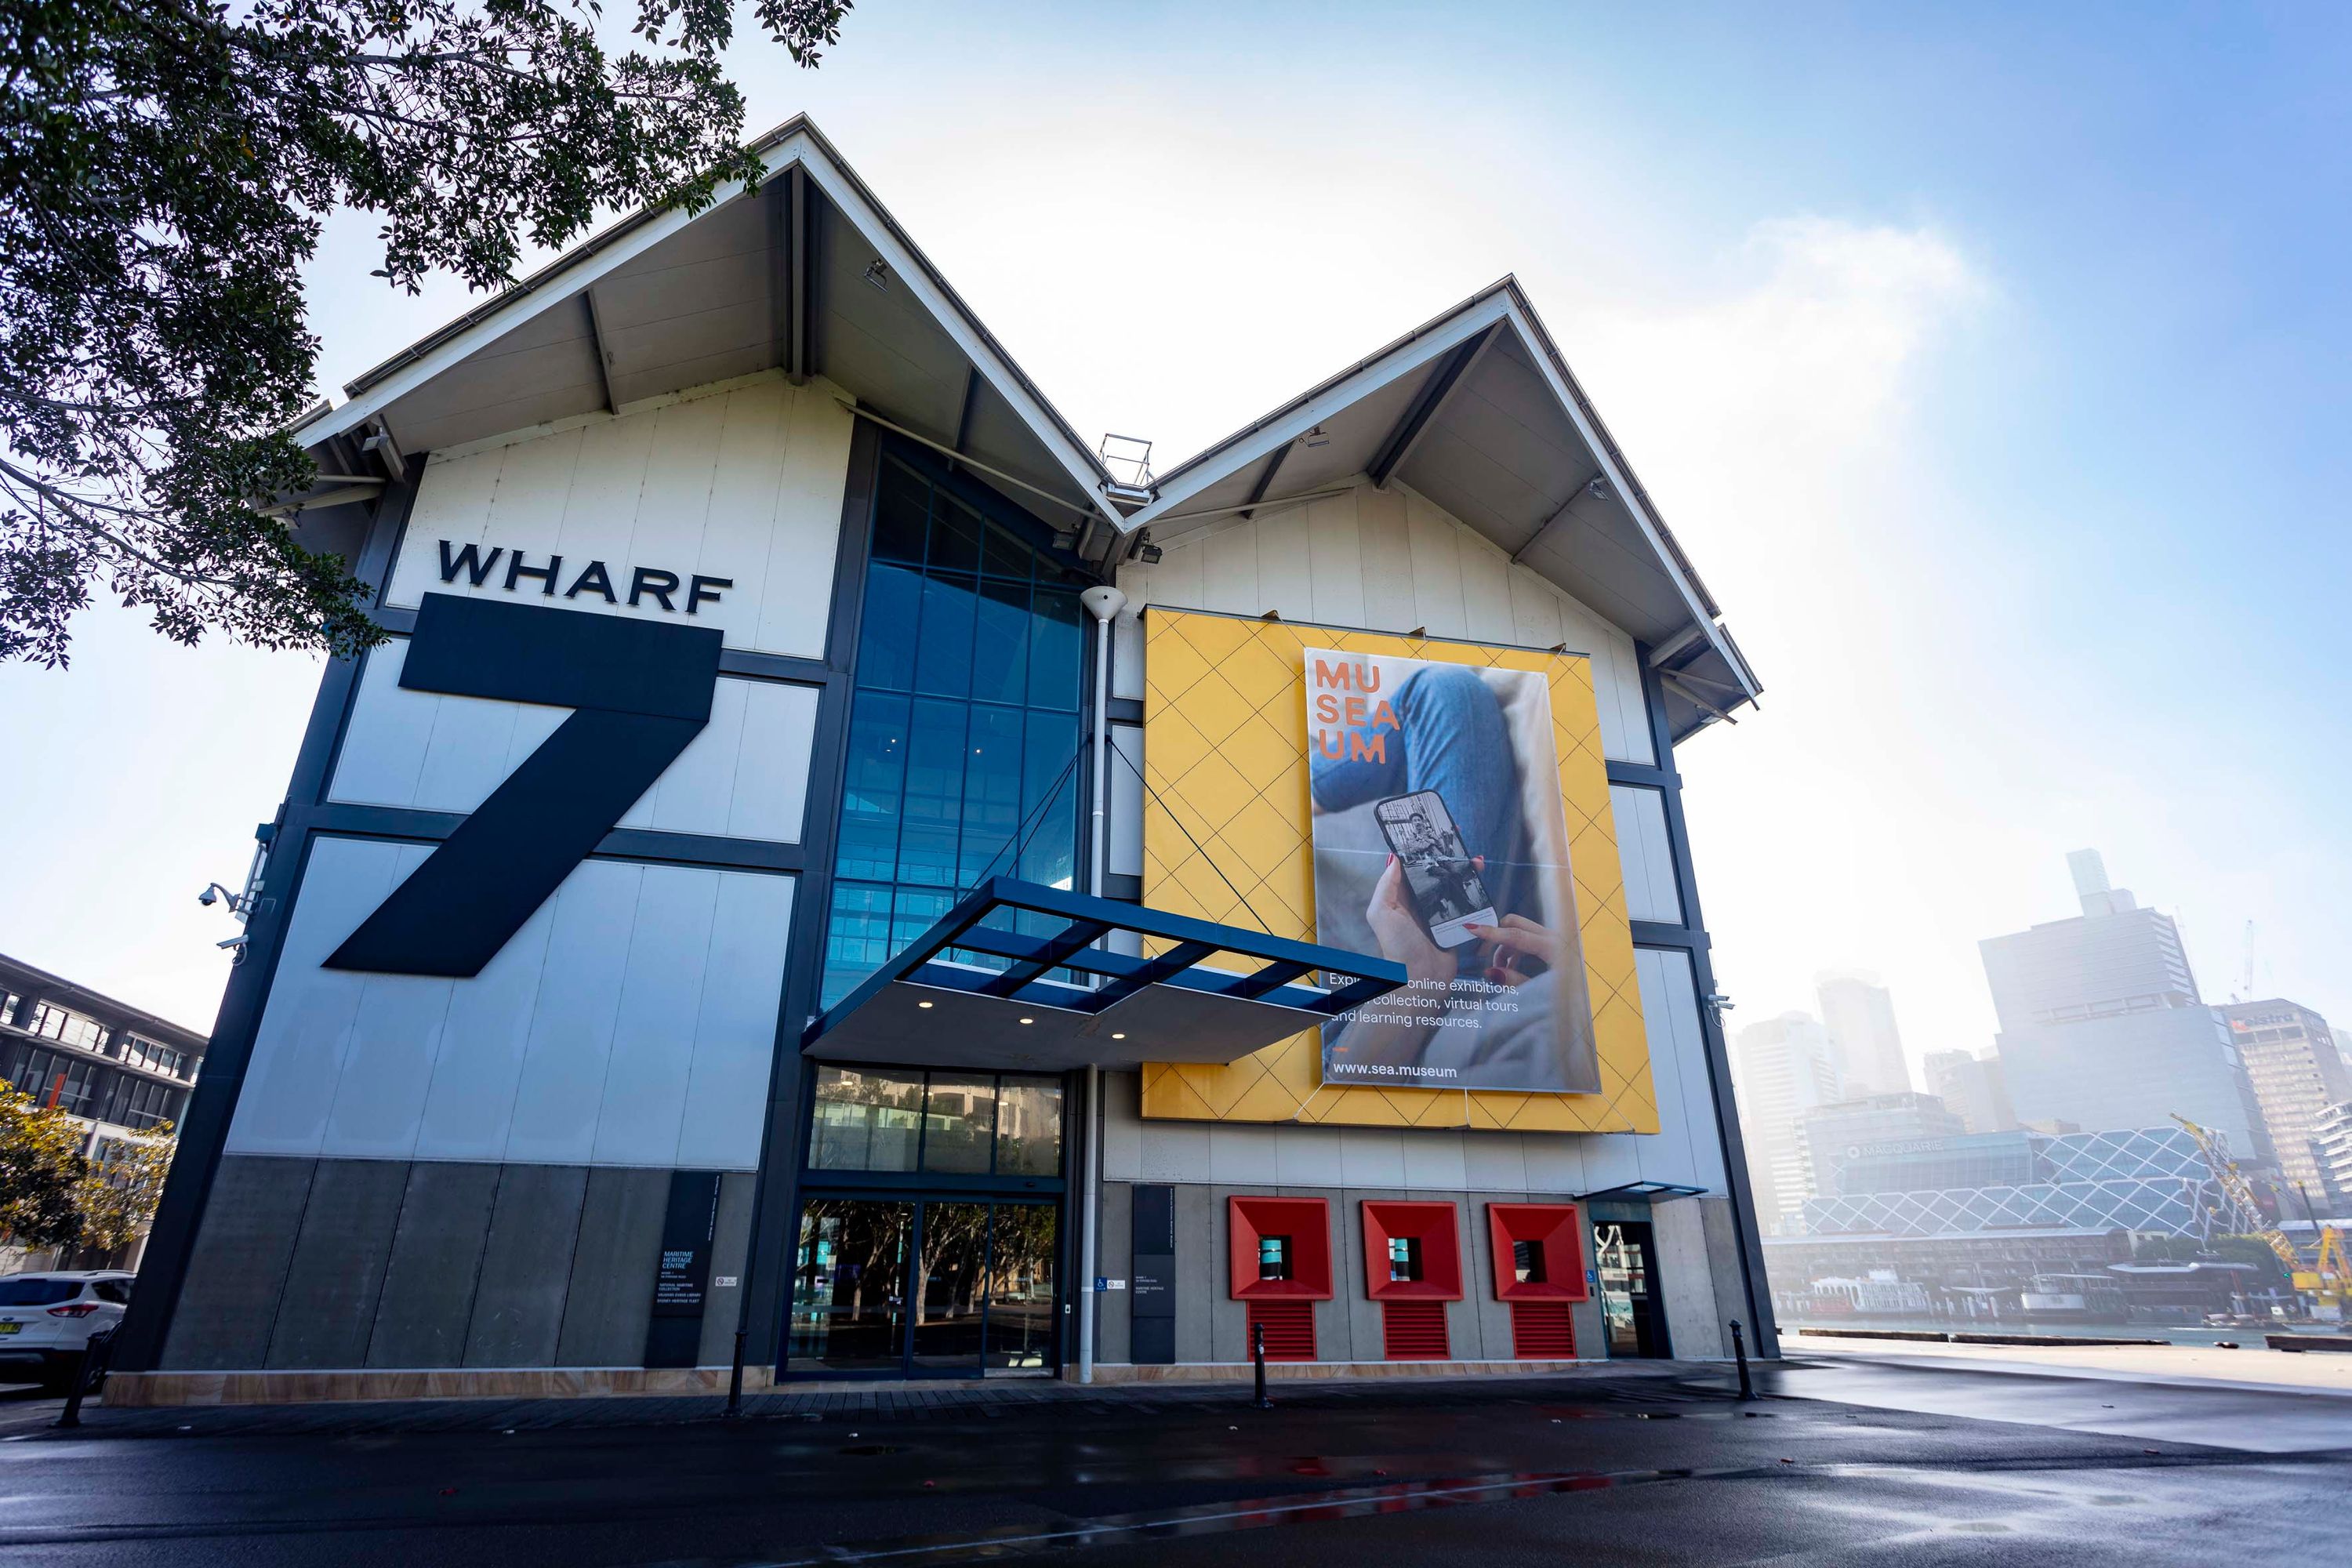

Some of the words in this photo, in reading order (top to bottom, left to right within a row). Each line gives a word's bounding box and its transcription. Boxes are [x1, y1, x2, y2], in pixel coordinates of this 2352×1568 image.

[437, 539, 734, 615] WHARF
[1316, 659, 1381, 693] MU
[1316, 694, 1400, 731] SEA
[1319, 729, 1386, 764] UM
[321, 592, 724, 978] 7
[1330, 972, 1363, 986] Exp
[1407, 978, 1446, 991] online
[1450, 981, 1520, 996] exhibitions,
[1373, 994, 1441, 1010] collection,
[1444, 998, 1483, 1011] virtual
[1486, 1000, 1519, 1012] tours
[1331, 1010, 1356, 1022] and
[1359, 1011, 1413, 1028] learning
[1416, 1015, 1483, 1029] resources.
[1333, 1062, 1457, 1078] www.sea.museum
[1863, 1140, 1944, 1156] MACQUARIE
